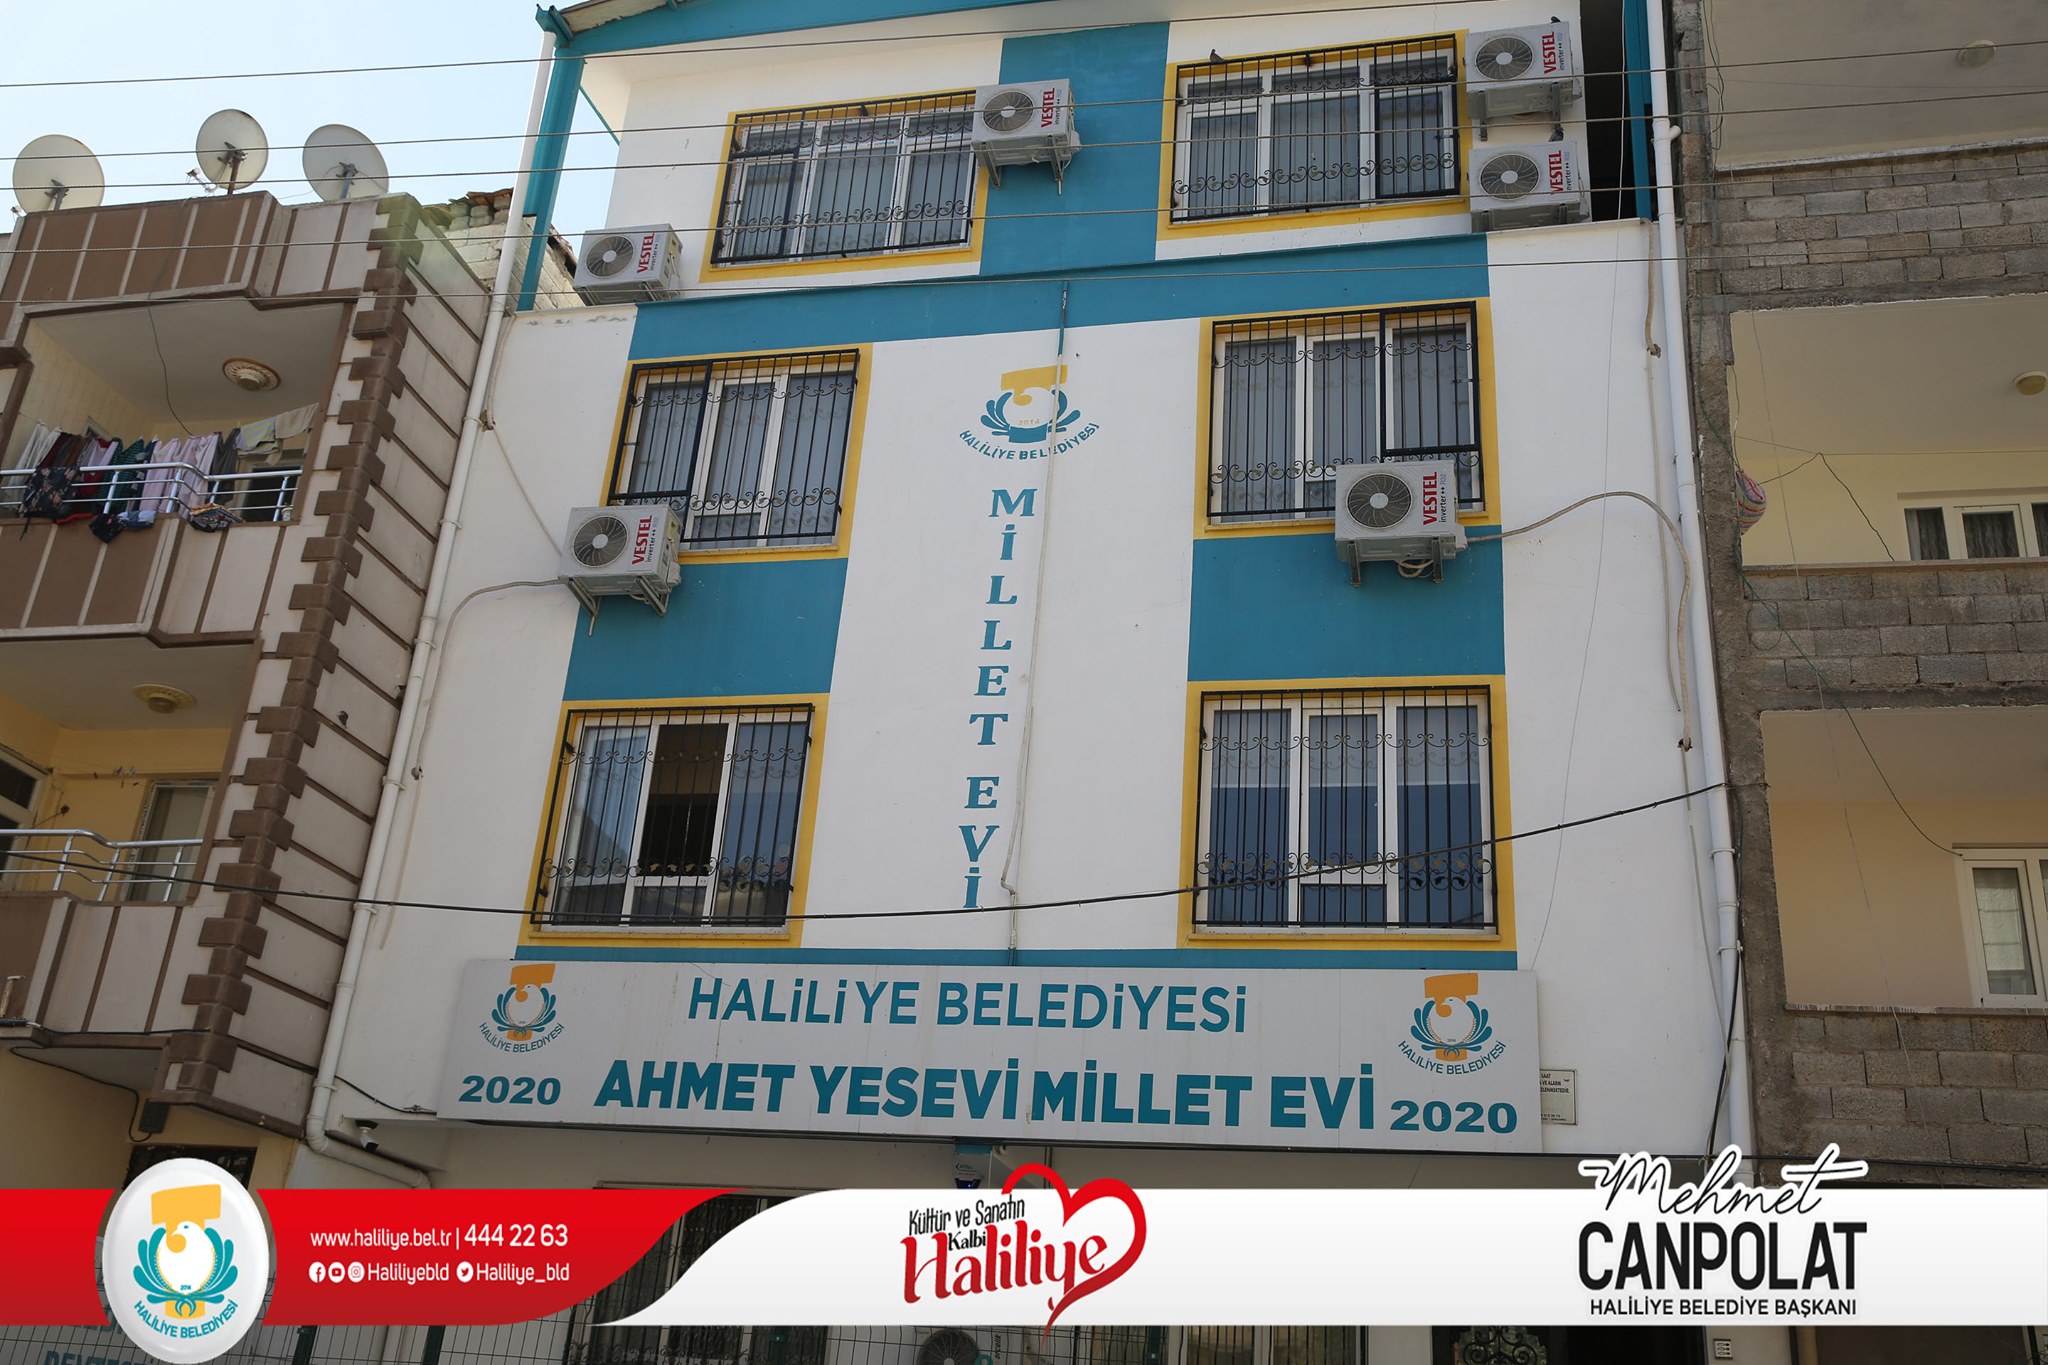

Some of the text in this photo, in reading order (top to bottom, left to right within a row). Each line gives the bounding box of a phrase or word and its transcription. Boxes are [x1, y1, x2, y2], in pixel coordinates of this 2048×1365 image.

[1542, 31, 1557, 74] VESTEL
[1041, 87, 1055, 128] VESTEL
[1549, 149, 1564, 195] VESTEL
[637, 231, 655, 273] VESTEL
[960, 430, 1016, 460] HALİLİYE
[1423, 471, 1438, 526] VESTEL
[631, 514, 653, 565] VESTEL
[958, 488, 1039, 909] MİLLET EVİ
[688, 977, 1247, 1033] HALİLİYE BELEDİYESİ
[457, 1074, 562, 1106] 2020
[594, 1056, 1375, 1130] AHMET YESEVİ MİLLET EVİ
[1389, 1100, 1518, 1134] 2020
